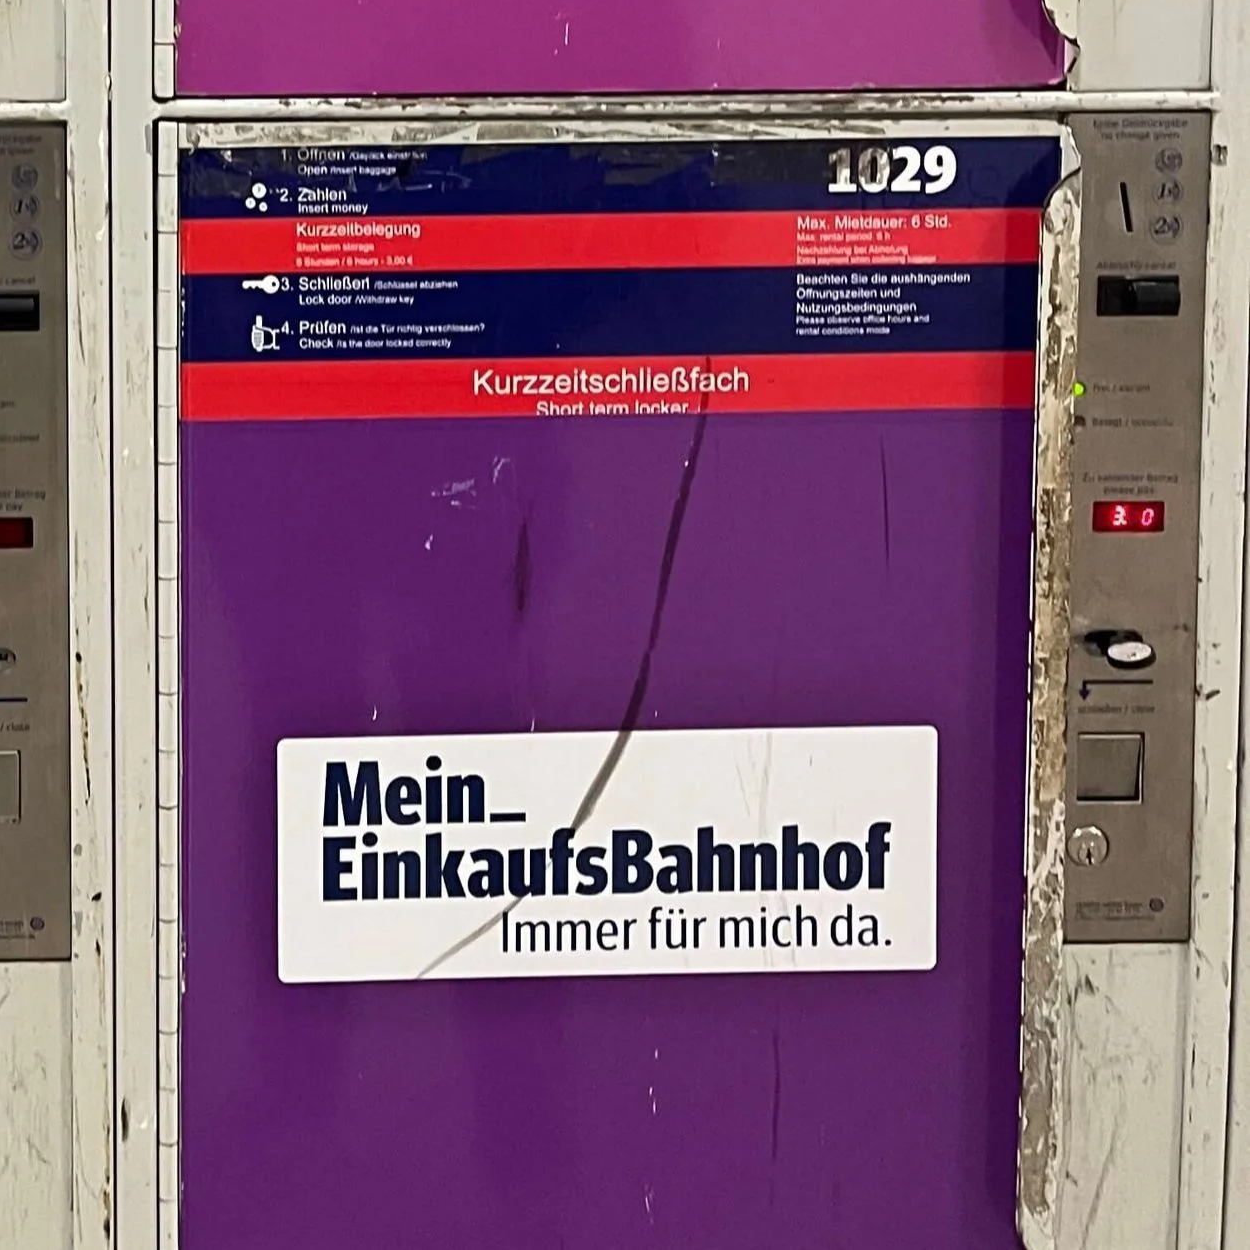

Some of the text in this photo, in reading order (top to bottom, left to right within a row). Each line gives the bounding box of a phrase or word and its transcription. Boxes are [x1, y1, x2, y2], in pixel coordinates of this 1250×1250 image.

[297, 146, 345, 161] Öffnen
[298, 164, 327, 177] Open
[828, 145, 957, 194] 1029
[280, 188, 347, 202] 2. Zahlen
[298, 203, 369, 216] Insert money
[797, 214, 951, 230] Max. Mietdauer: 6 Std.
[296, 222, 421, 239] Kurzzeitbelegung
[281, 276, 370, 292] 3. Schließen
[796, 272, 971, 285] Beachten Sie die aushängenden
[299, 294, 352, 306] Lock door
[796, 287, 901, 301] Öffnungszeiten und
[796, 302, 917, 315] Nutzungsbedingungen
[281, 320, 346, 336] 4. Prüfen
[299, 338, 333, 349] Check
[473, 367, 749, 396] Kurzzeitschließfach
[536, 400, 689, 417] Short term locker
[322, 822, 891, 902] EinkaufsBahnhof
[501, 905, 892, 953] Immer für mich da.
